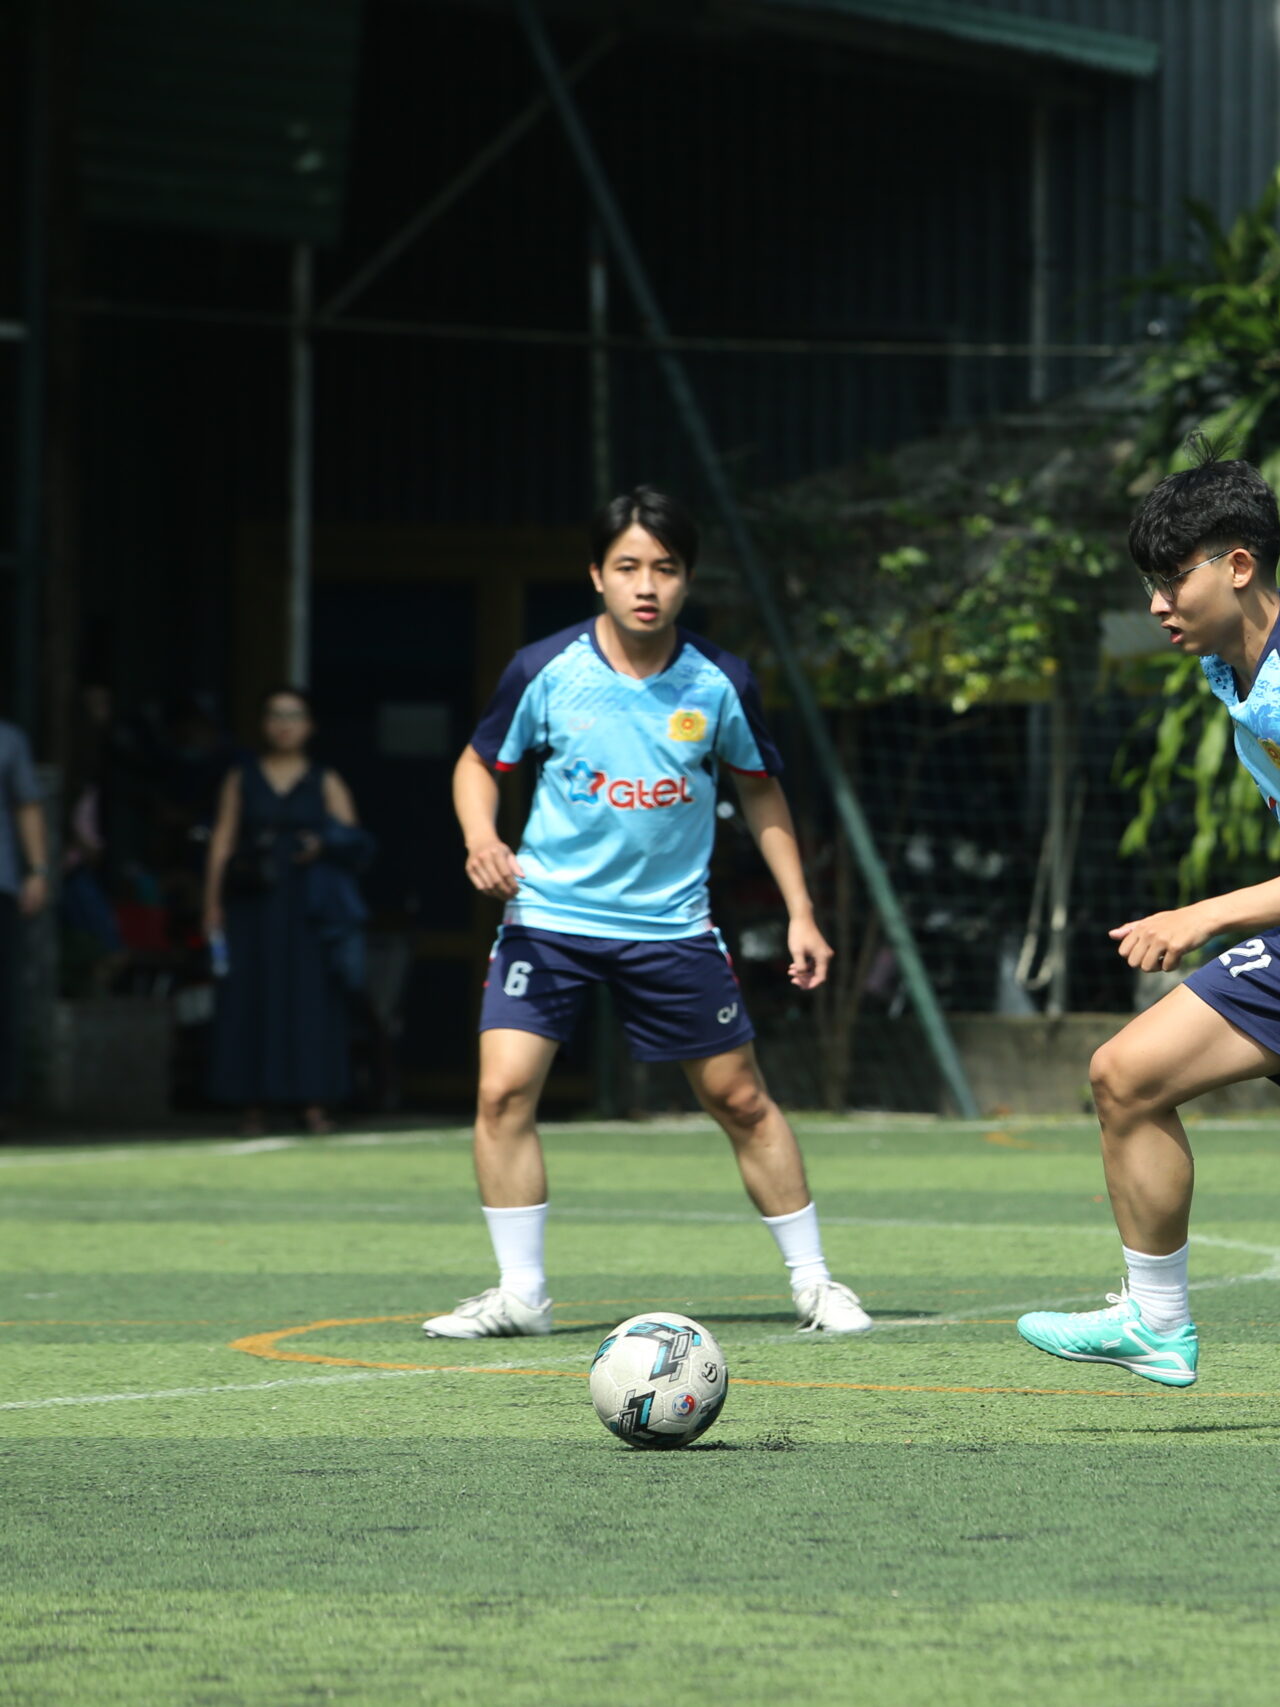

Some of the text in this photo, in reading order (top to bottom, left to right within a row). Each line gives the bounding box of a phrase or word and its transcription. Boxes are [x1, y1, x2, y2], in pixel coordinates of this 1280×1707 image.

[607, 776, 695, 810] Gtel
[1218, 938, 1272, 978] 21
[503, 960, 534, 997] 6
